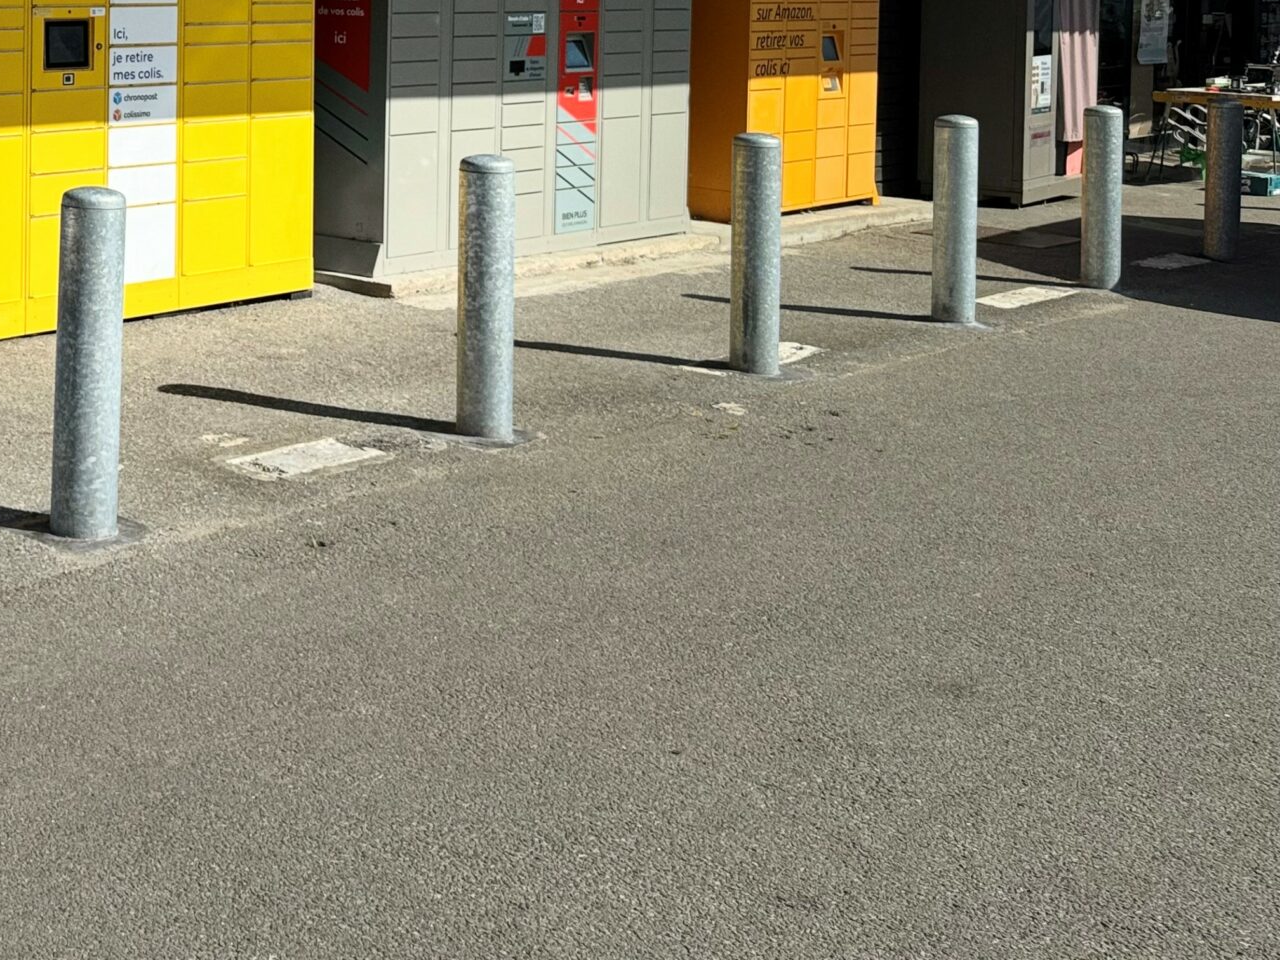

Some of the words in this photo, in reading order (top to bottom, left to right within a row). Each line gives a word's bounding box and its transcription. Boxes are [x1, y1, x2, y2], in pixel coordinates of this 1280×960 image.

[318, 6, 328, 15] de
[330, 8, 344, 16] vos
[346, 7, 365, 16] colis
[756, 8, 771, 20] sur
[774, 4, 814, 21] Amazon,
[113, 28, 129, 41] Ici,
[334, 30, 347, 44] ici
[756, 32, 787, 49] retirez
[789, 33, 805, 47] vos
[112, 51, 123, 67] je
[125, 50, 154, 64] retire
[113, 69, 136, 81] mes
[138, 67, 164, 80] colis.
[755, 60, 777, 76] colis
[779, 59, 790, 74] ici
[124, 92, 158, 102] chronopost
[124, 110, 151, 119] colissimo
